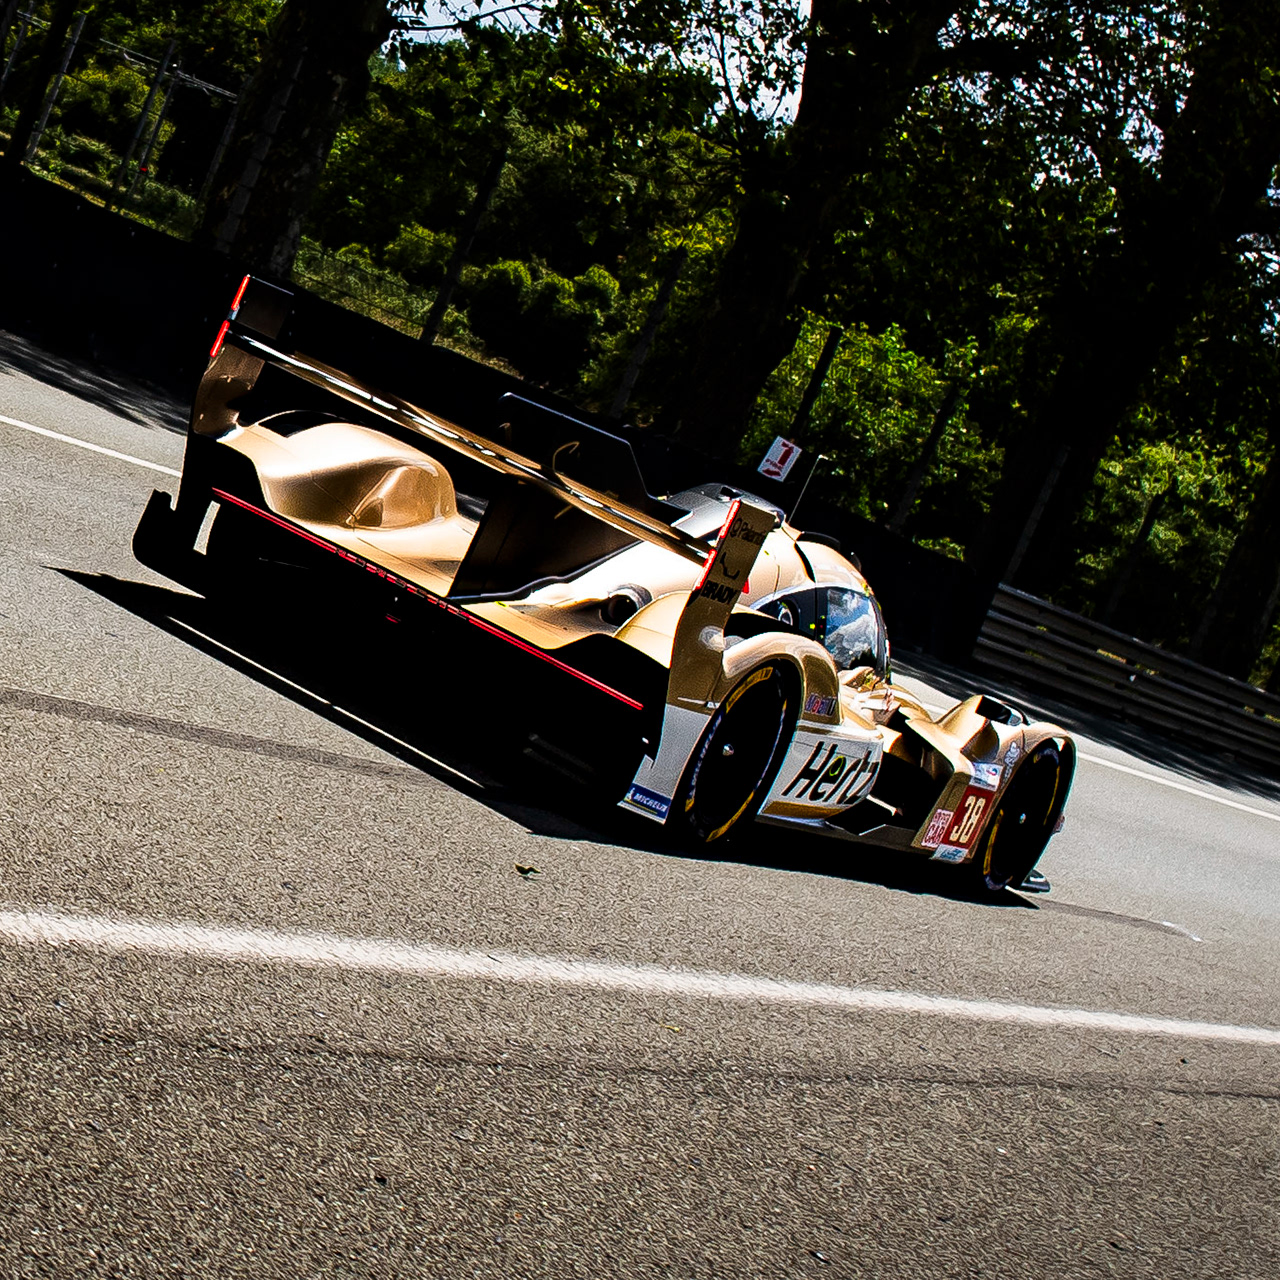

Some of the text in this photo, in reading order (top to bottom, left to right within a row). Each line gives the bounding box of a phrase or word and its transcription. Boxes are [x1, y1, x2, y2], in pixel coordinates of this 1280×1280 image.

[701, 580, 738, 605] BRADY
[781, 741, 880, 805] Hertz
[633, 793, 669, 812] MICHELIN
[949, 795, 986, 844] 38
